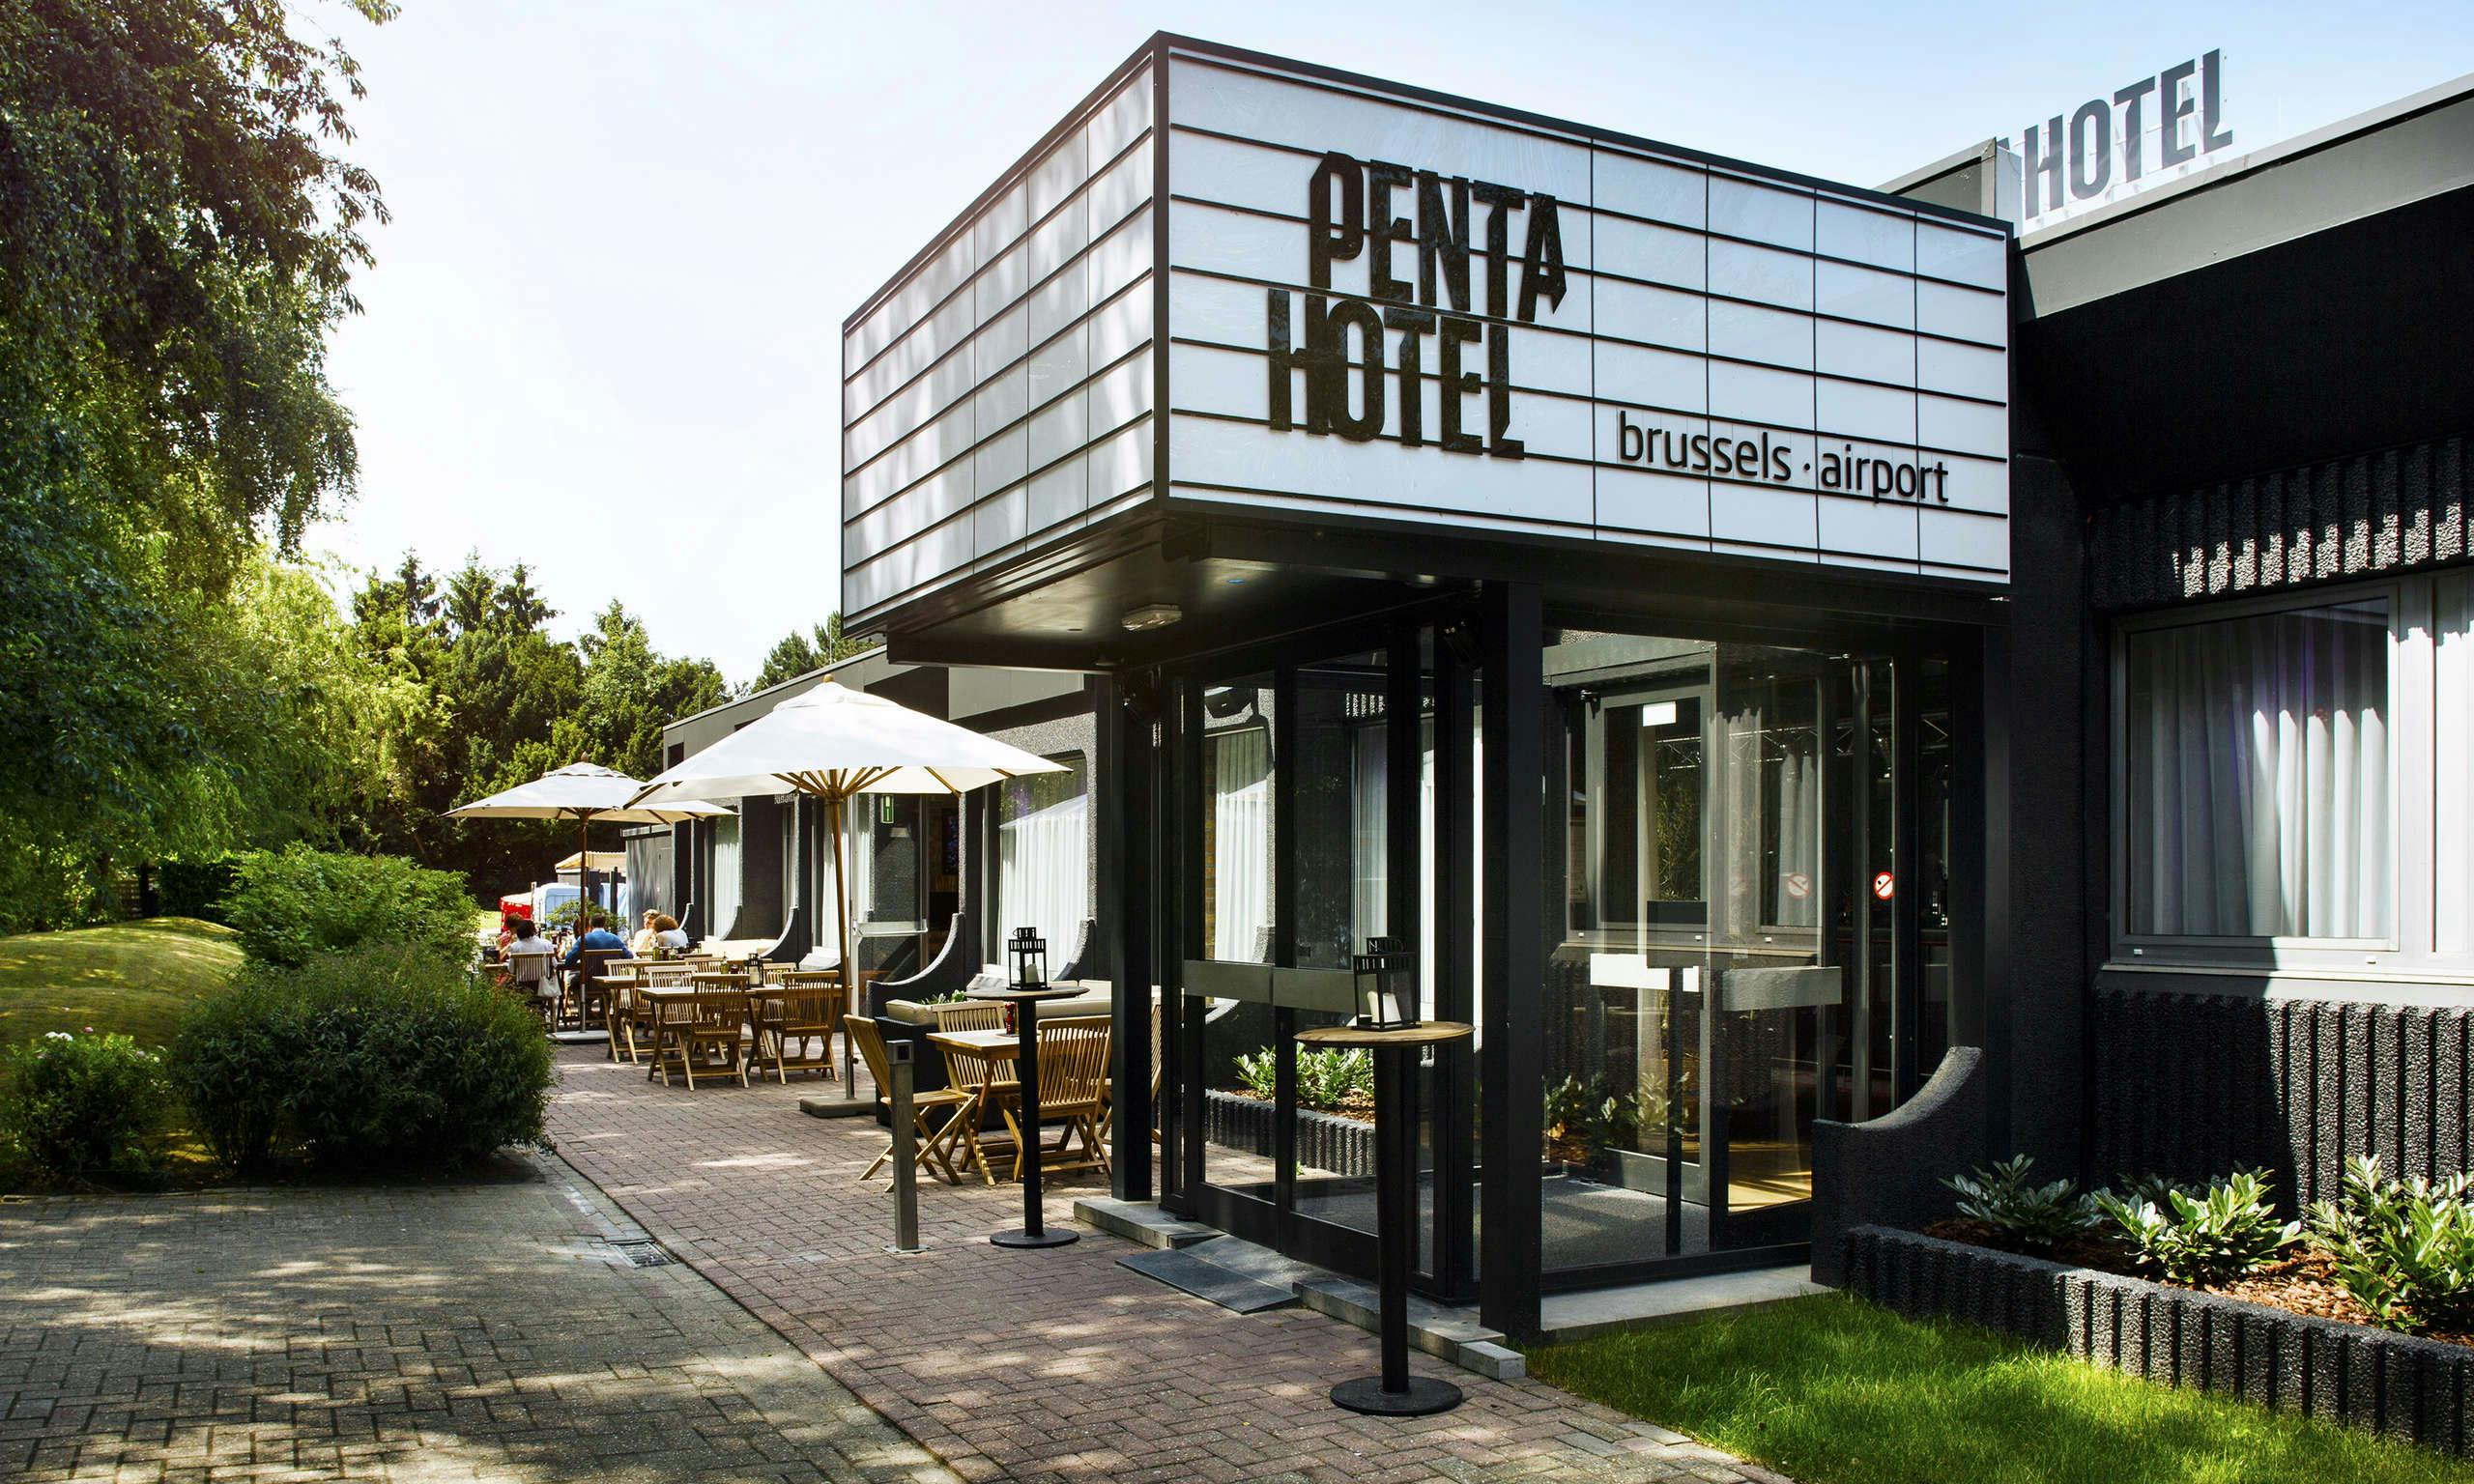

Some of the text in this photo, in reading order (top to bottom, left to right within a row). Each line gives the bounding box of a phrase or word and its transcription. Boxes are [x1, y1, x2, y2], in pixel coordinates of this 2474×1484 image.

[2025, 47, 2232, 220] HOTEL
[1309, 151, 1567, 322] PENTA
[1268, 288, 1524, 460] HOTEL
[1620, 411, 1792, 481] brussels
[1821, 444, 1949, 503] airport
